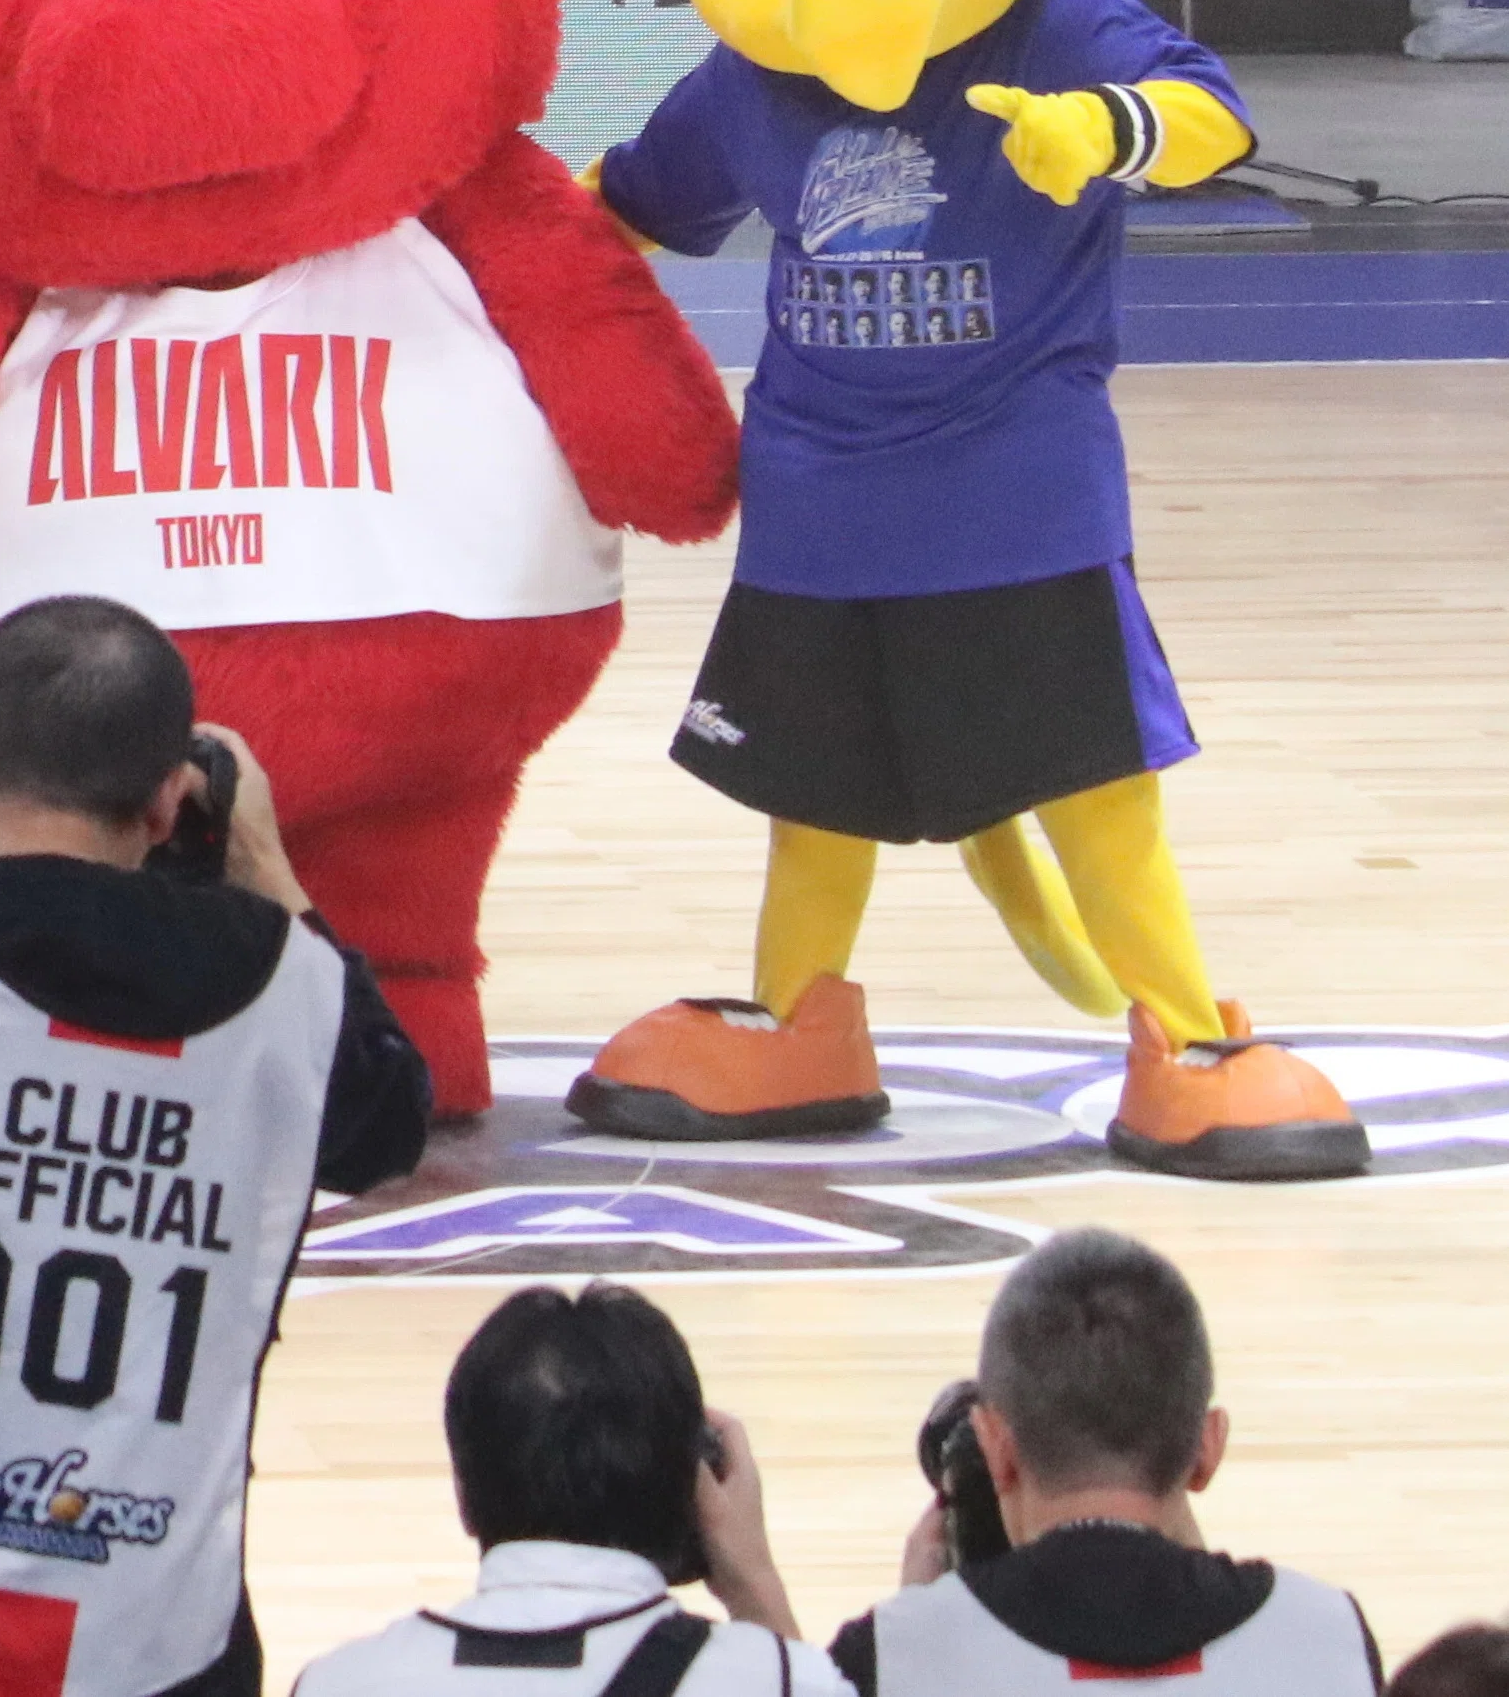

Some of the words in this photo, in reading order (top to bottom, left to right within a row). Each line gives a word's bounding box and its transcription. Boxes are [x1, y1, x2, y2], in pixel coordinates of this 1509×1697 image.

[27, 333, 394, 506] ALVARK
[155, 512, 264, 570] TOKYO
[5, 1076, 194, 1168] CLUB
